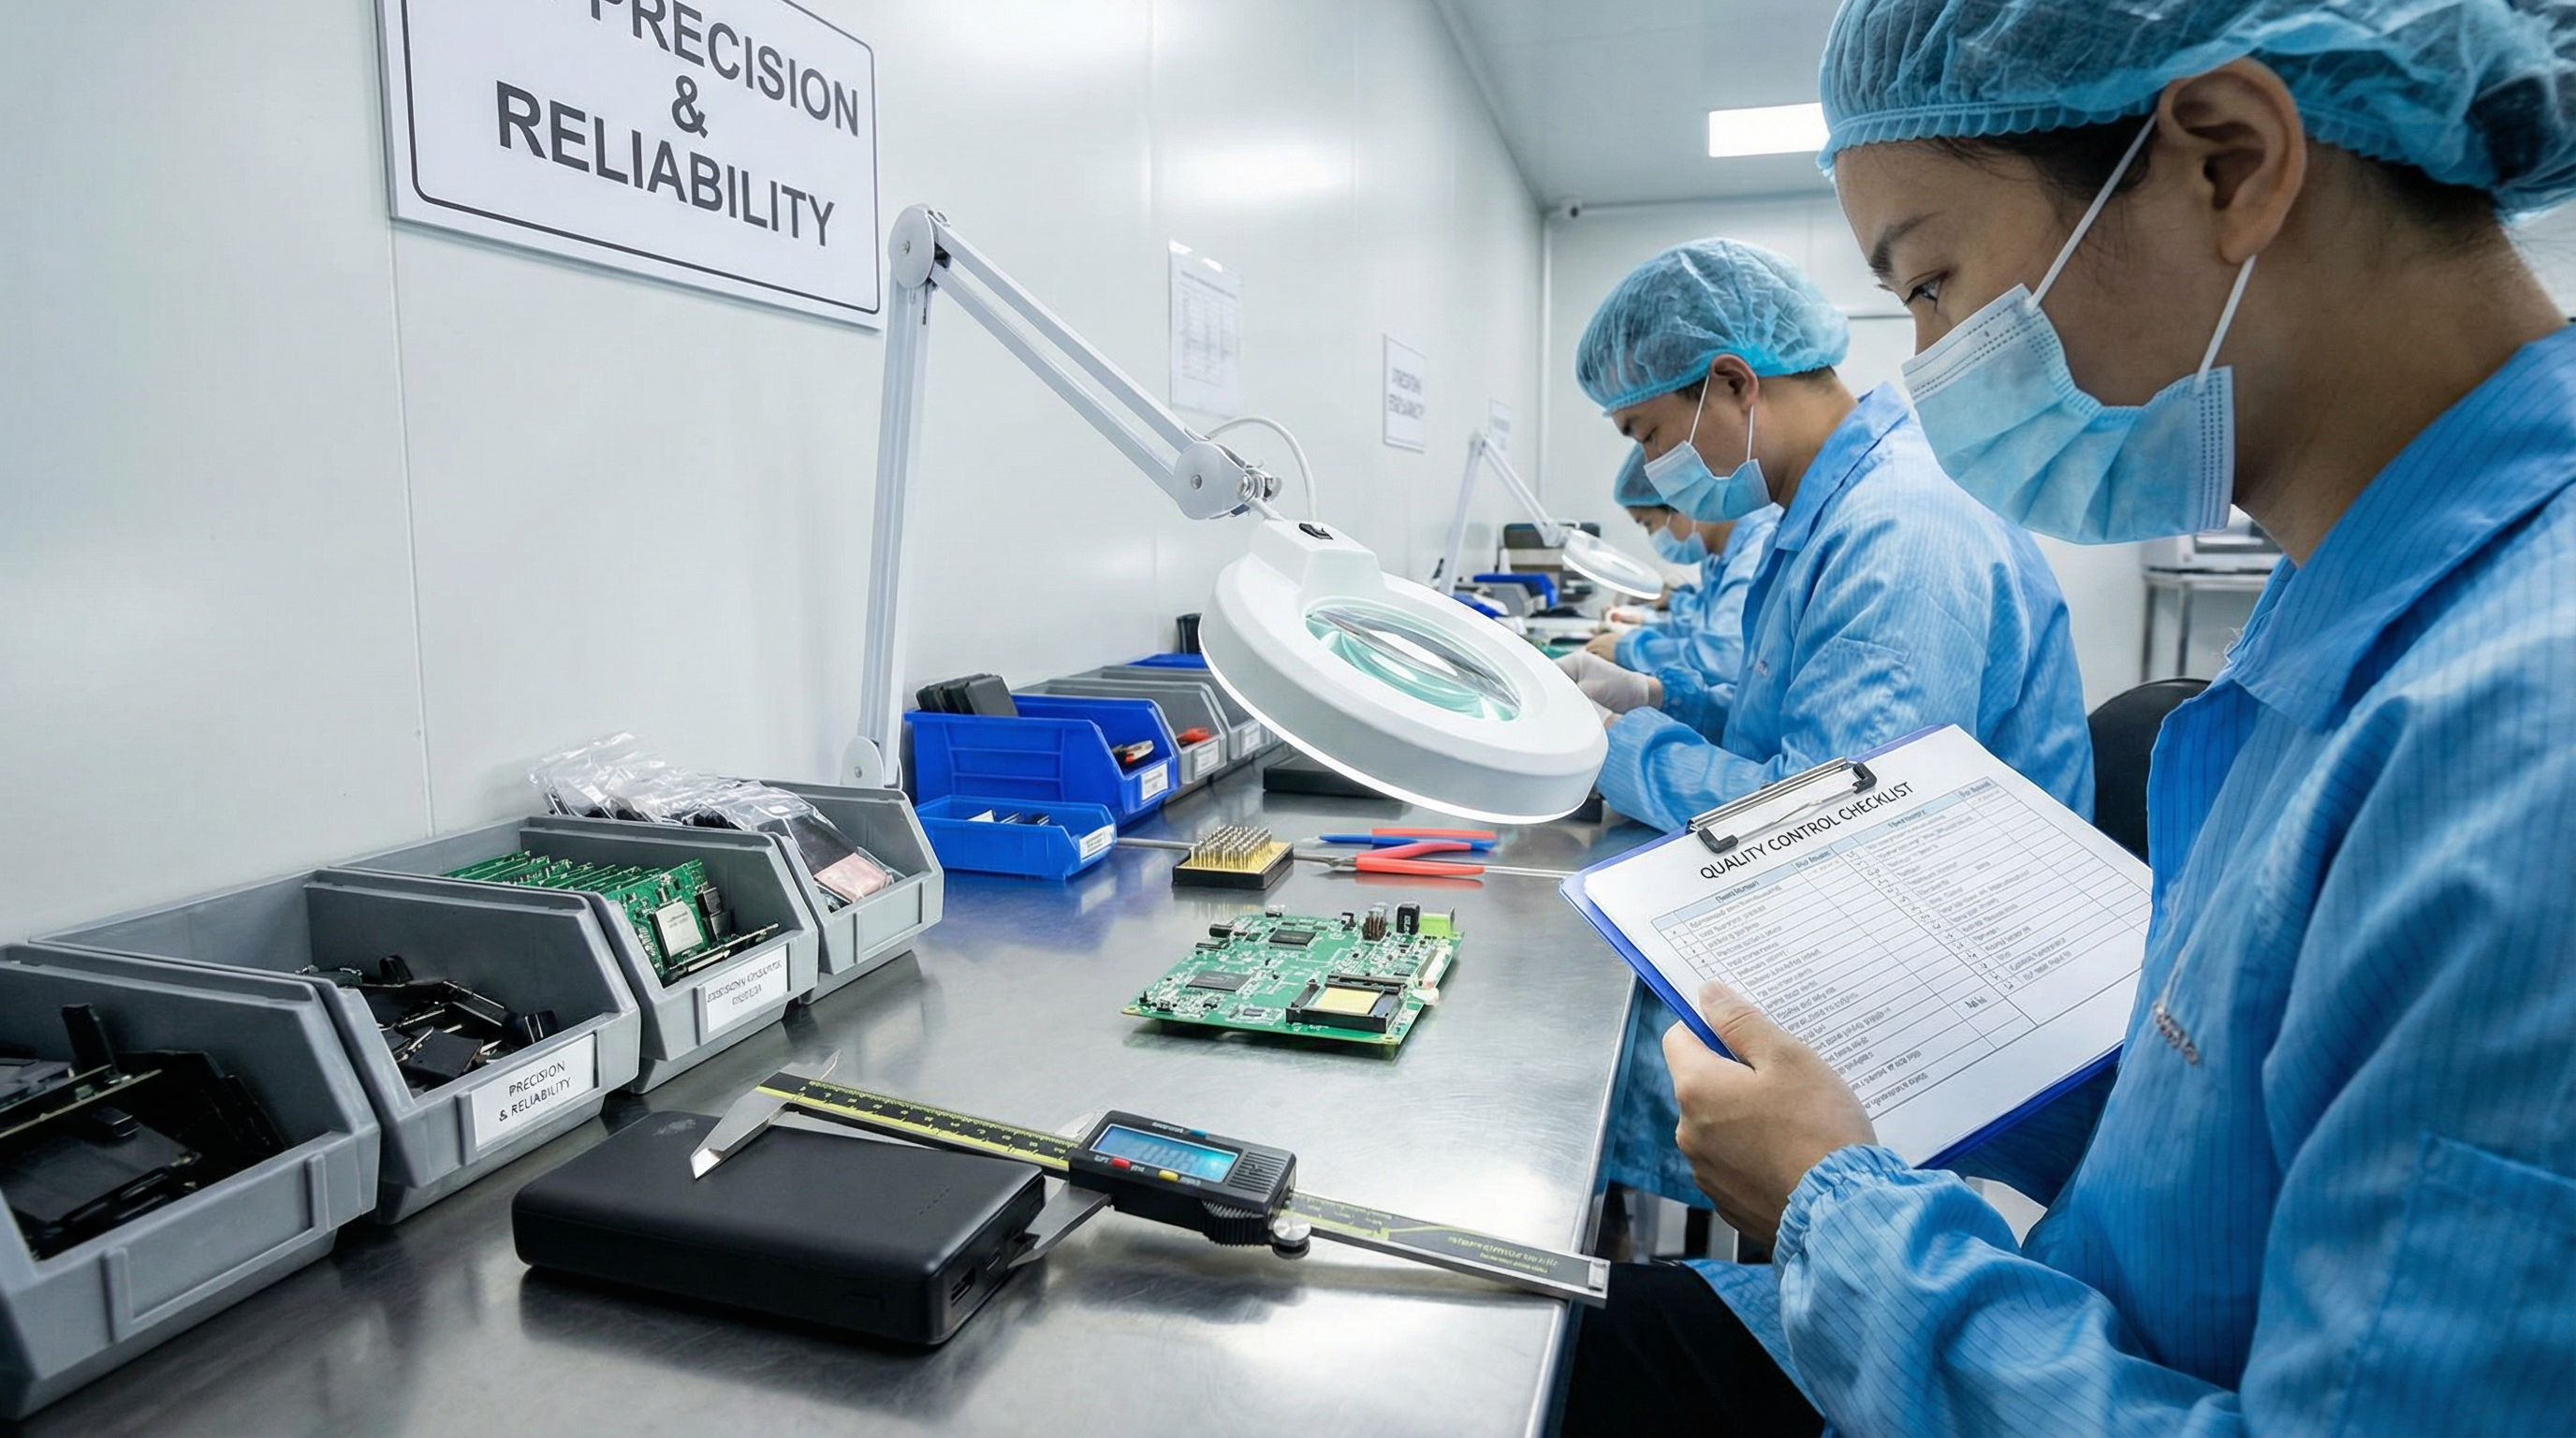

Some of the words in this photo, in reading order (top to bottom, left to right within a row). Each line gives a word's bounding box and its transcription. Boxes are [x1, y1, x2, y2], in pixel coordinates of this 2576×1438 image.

[671, 75, 708, 139] &
[496, 81, 835, 247] RELIABILITY
[1700, 844, 1767, 879] QUALITY
[1768, 814, 1841, 851] CONTROL
[1838, 781, 1913, 821] CHECKLIST
[509, 1060, 565, 1096] PRECISION
[511, 1077, 571, 1116] RELIABILITY
